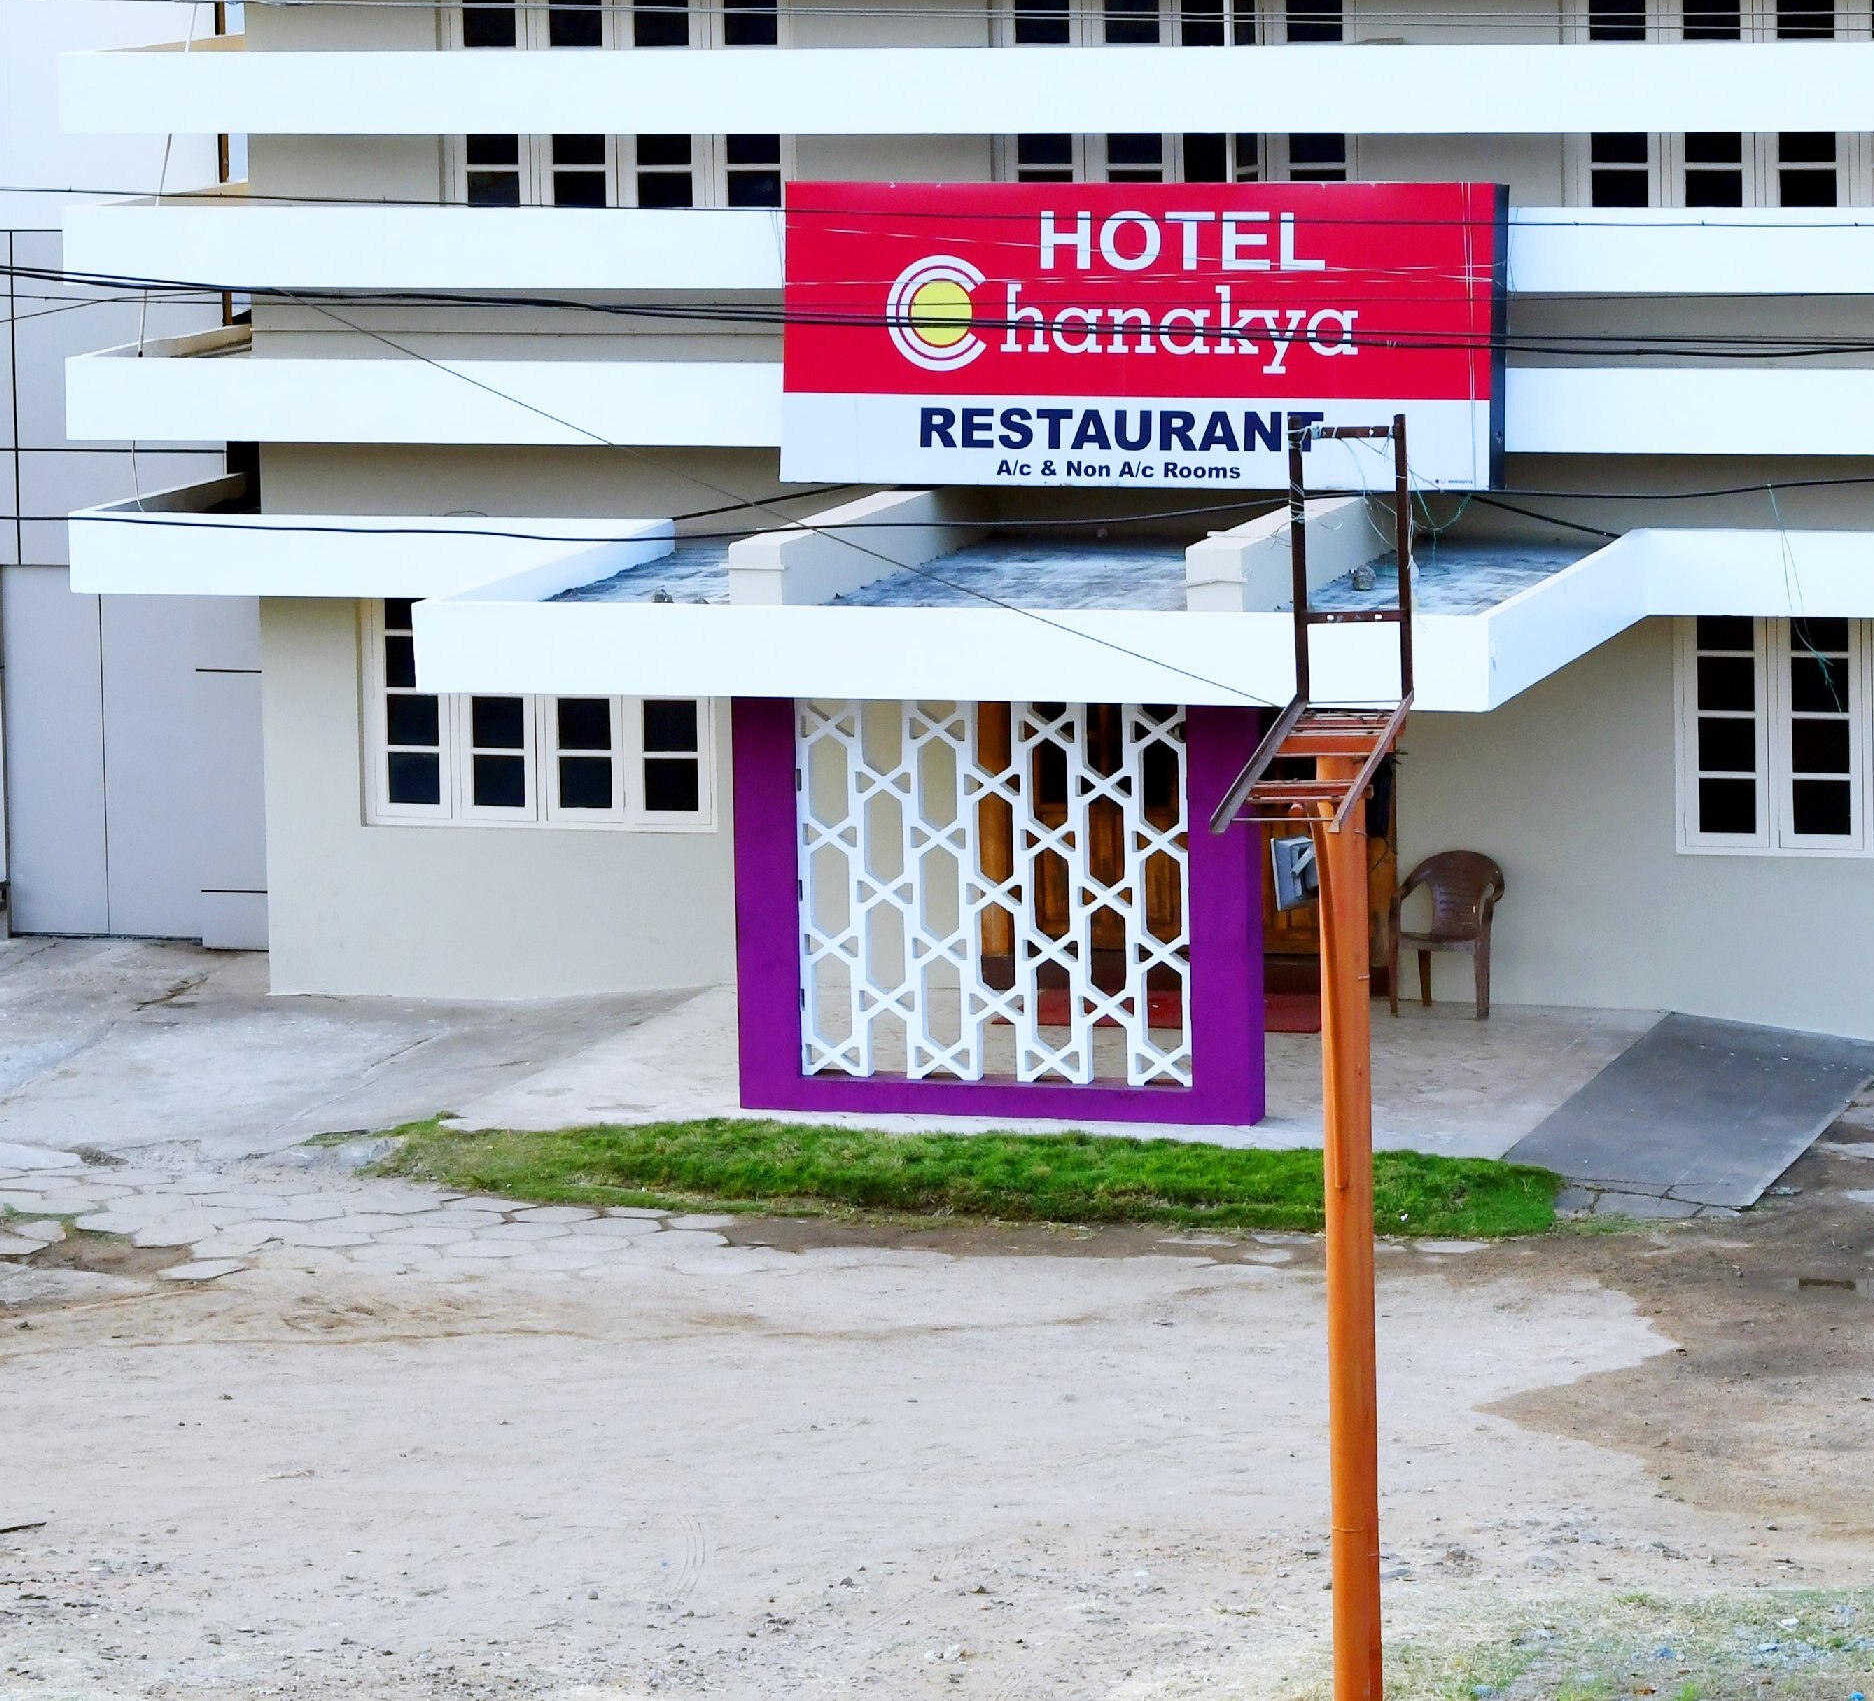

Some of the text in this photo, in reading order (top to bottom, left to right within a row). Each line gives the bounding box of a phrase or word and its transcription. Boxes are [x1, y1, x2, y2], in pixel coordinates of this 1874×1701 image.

[1039, 209, 1326, 272] HOTEL
[919, 407, 1324, 452] RESTAURANT
[996, 459, 1241, 480] A/c & Non A/c Rooms
